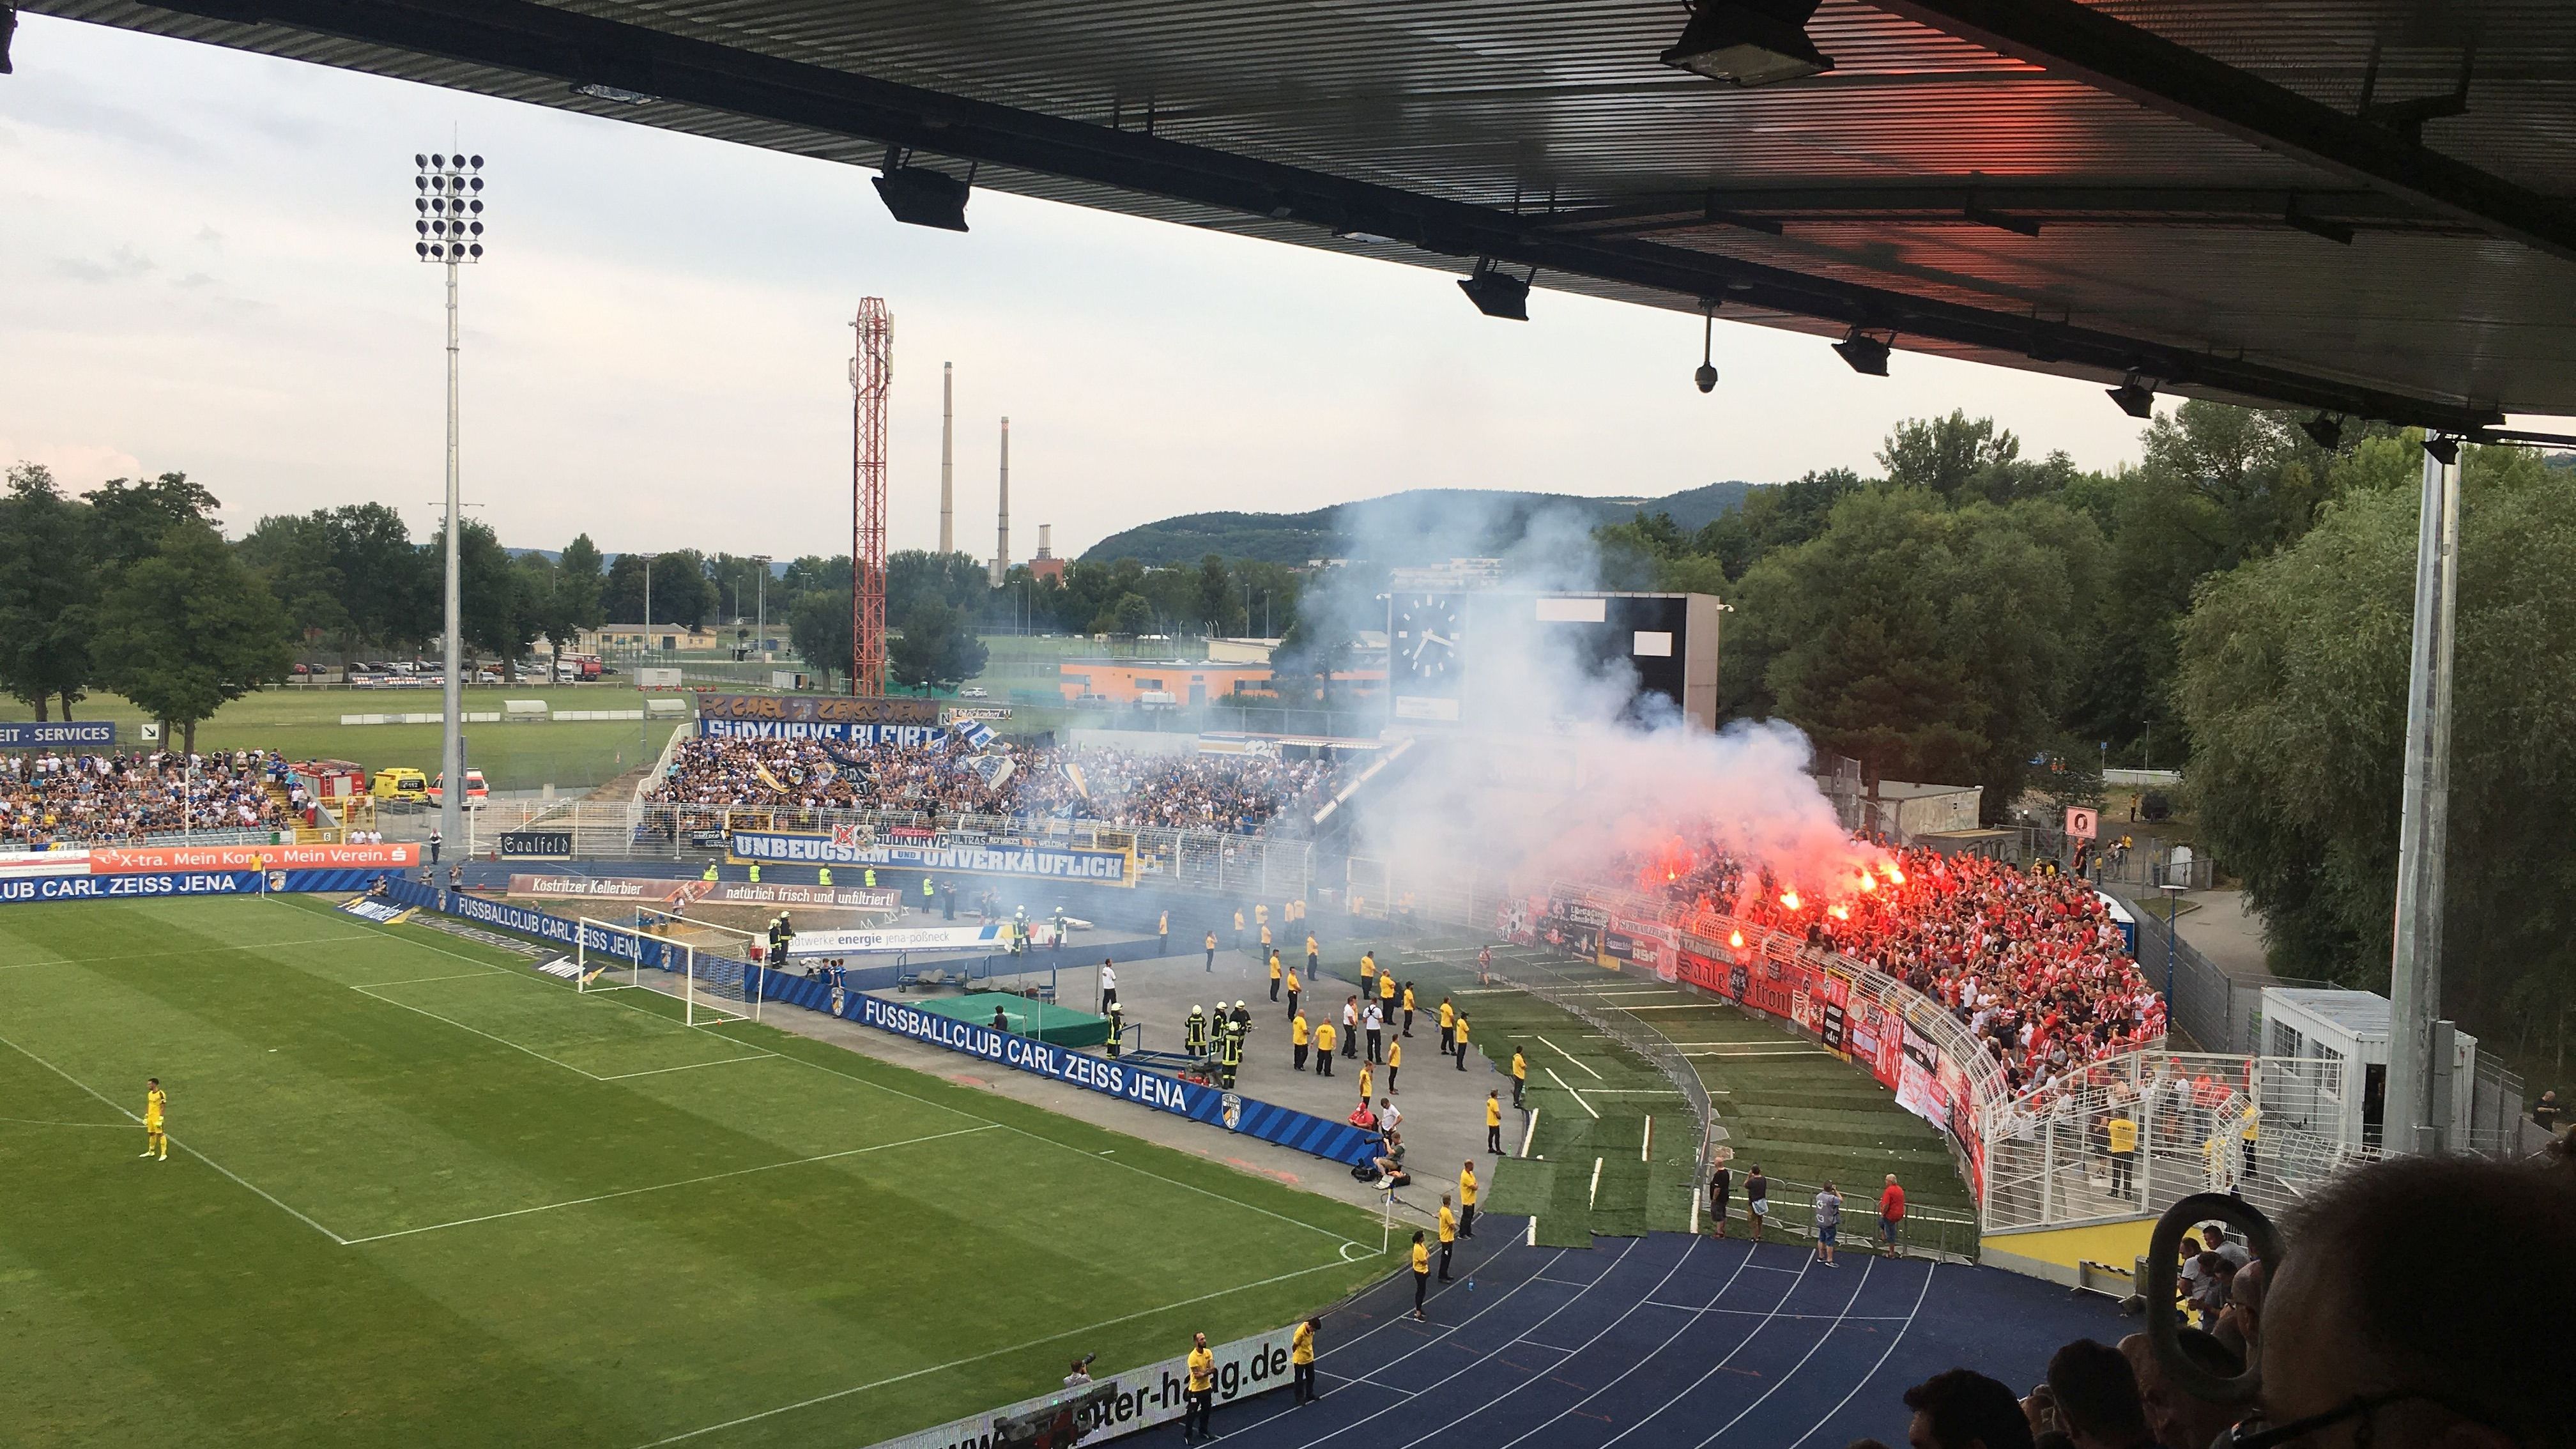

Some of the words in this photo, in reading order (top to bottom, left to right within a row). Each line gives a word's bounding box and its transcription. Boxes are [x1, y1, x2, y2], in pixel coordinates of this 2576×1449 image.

[34, 727, 109, 741] SERVICES
[504, 836, 568, 854] Saalfeld
[951, 834, 986, 847] ULTRAS
[119, 854, 167, 867] X-tra.
[174, 852, 216, 866] Mein
[223, 850, 278, 864] Kono.
[284, 848, 325, 863] Mein
[330, 848, 388, 862] Verein.
[898, 850, 916, 859] UND
[923, 847, 1122, 878] UNVERKÄUFLICH
[0, 882, 35, 899] UB
[42, 878, 103, 897] CARL
[109, 876, 173, 895] ZEISS
[179, 874, 236, 893] JENA
[532, 878, 587, 893] Köstritzer
[590, 879, 643, 895] Kellerbier
[726, 887, 775, 901] natürlich
[778, 888, 810, 903] frisch
[813, 890, 834, 903] und
[838, 891, 894, 907] unfiltriert!
[459, 897, 539, 933] FUSSBALLCLUB
[542, 917, 572, 942] CARL
[574, 926, 608, 951] ZEISS
[610, 935, 643, 960] JENA
[838, 933, 882, 947] energie
[866, 999, 1002, 1058] FUSSBALLCLUB
[1008, 1038, 1060, 1075] CARL
[1064, 1054, 1123, 1093] ZEISS
[1129, 1072, 1186, 1112] JENA
